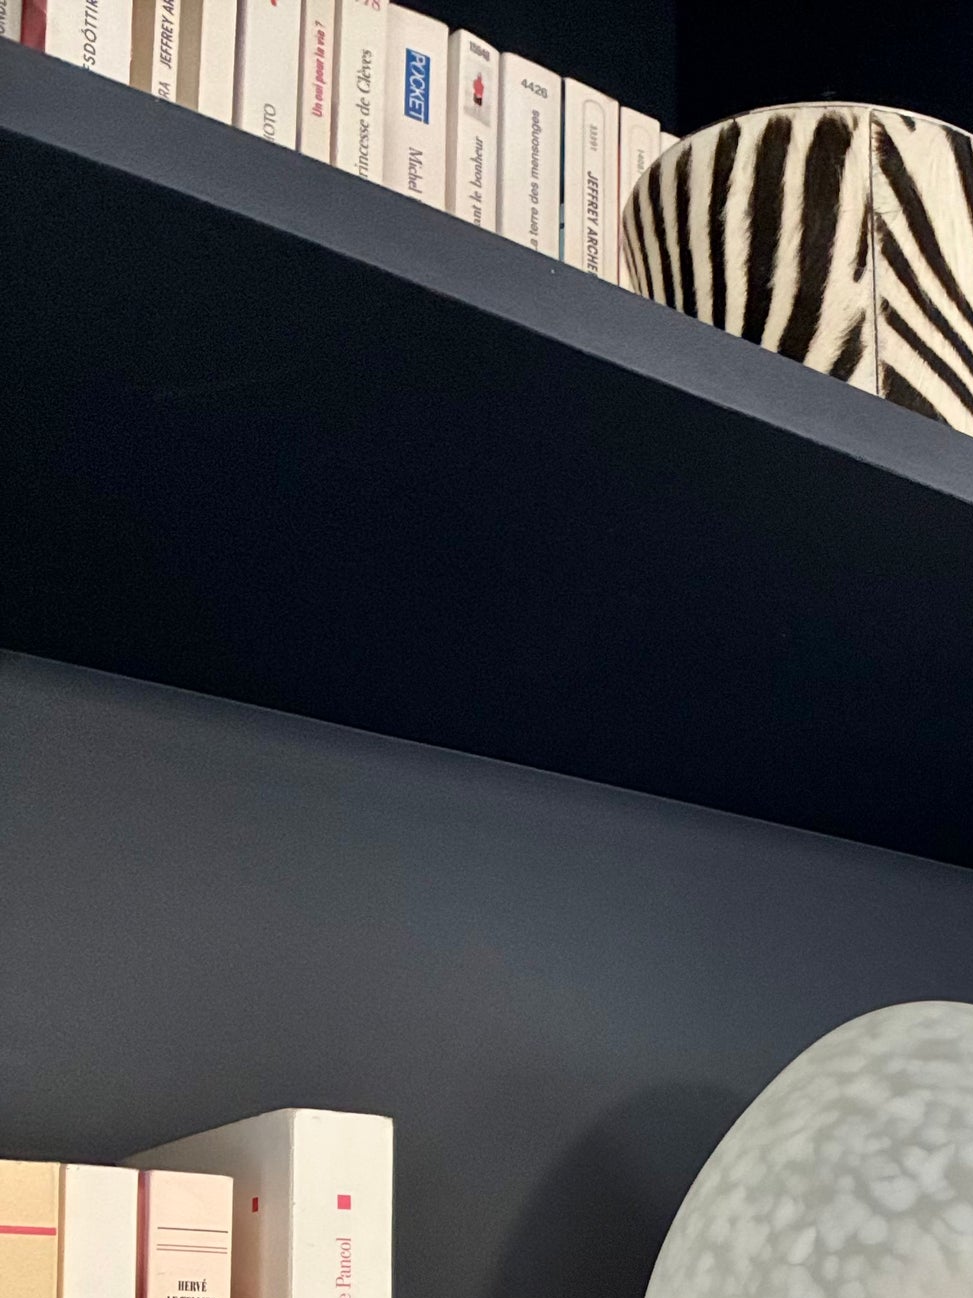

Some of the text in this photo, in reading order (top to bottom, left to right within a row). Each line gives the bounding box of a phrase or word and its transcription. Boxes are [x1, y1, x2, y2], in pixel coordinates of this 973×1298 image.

[159, 15, 174, 69] JEFFREY
[313, 47, 325, 58] la
[314, 58, 326, 85] pour
[357, 49, 372, 93] Clèves
[312, 83, 323, 102] oui
[408, 51, 427, 123] POCKET
[311, 102, 322, 118] Un
[355, 99, 371, 114] de
[530, 110, 542, 178] mensonges
[408, 147, 423, 194] Michel
[469, 136, 484, 190] bonheur
[469, 191, 482, 203] le
[528, 181, 539, 204] des
[587, 171, 599, 226] JEFFREY
[528, 209, 539, 237] terre
[335, 1237, 352, 1288] Pancol
[178, 1278, 207, 1292] HERVÉ
